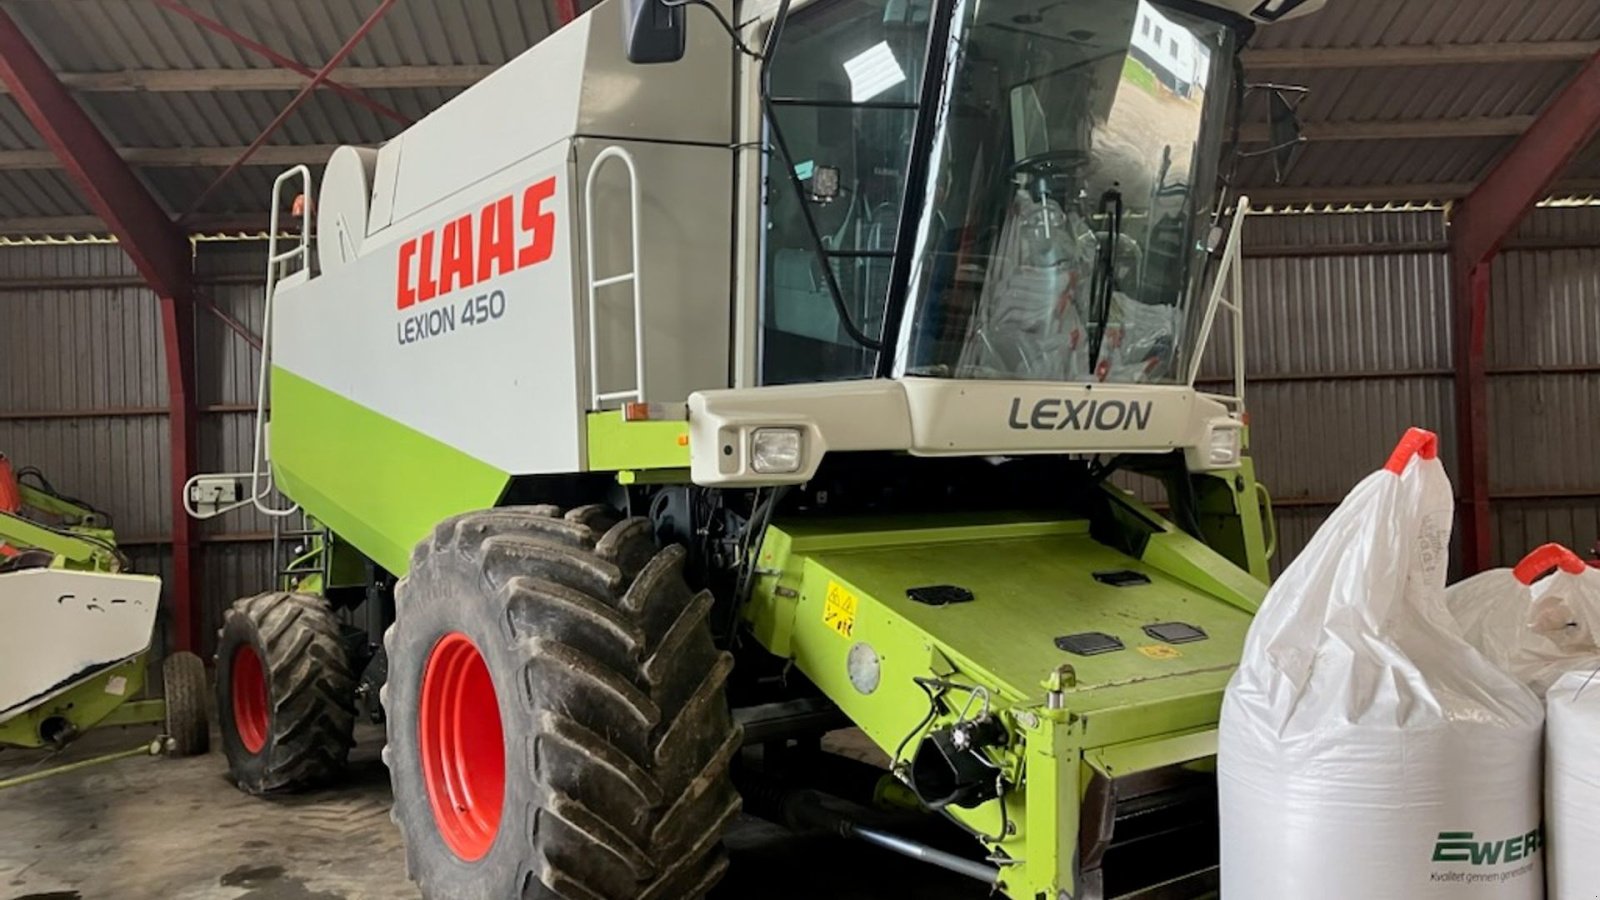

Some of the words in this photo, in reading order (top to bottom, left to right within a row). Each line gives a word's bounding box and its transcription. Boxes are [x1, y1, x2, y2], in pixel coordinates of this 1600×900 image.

[397, 175, 556, 310] CLAAS
[397, 304, 455, 345] LEXION
[461, 289, 506, 326] 450
[1008, 397, 1153, 431] LEXION
[1430, 871, 1465, 882] Kvalitet
[1466, 872, 1499, 884] gennem
[1500, 863, 1534, 883] genera
